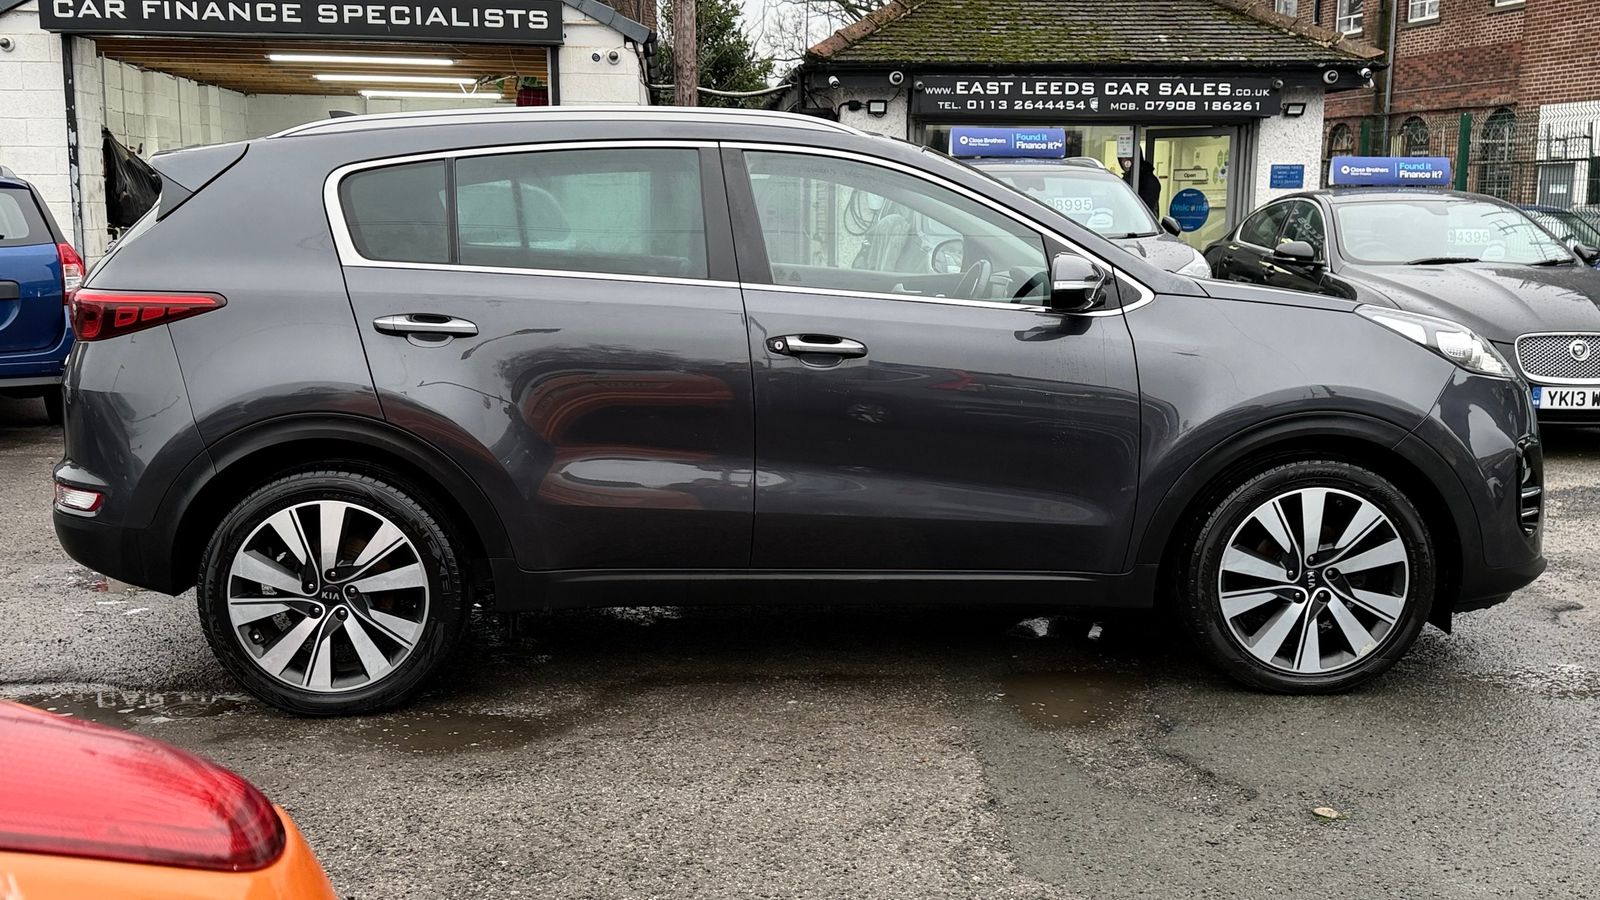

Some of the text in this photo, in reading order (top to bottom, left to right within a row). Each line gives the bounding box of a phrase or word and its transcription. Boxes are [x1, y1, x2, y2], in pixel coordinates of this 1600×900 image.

[53, 0, 549, 30] CAR FINANCE SPECIALISTS
[1021, 82, 1095, 95] LEEDS
[1104, 82, 1150, 96] CAR
[938, 100, 1261, 111] TEL. 0113 2644454 MOB. 07908 186261
[1016, 133, 1048, 141] Found it
[1016, 141, 1058, 150] Finance it?
[1400, 162, 1432, 170] Found it
[1400, 170, 1443, 179] Finance it?
[1548, 391, 1587, 407] YK13
[1307, 571, 1316, 589] KIA
[321, 591, 340, 600] KIA
